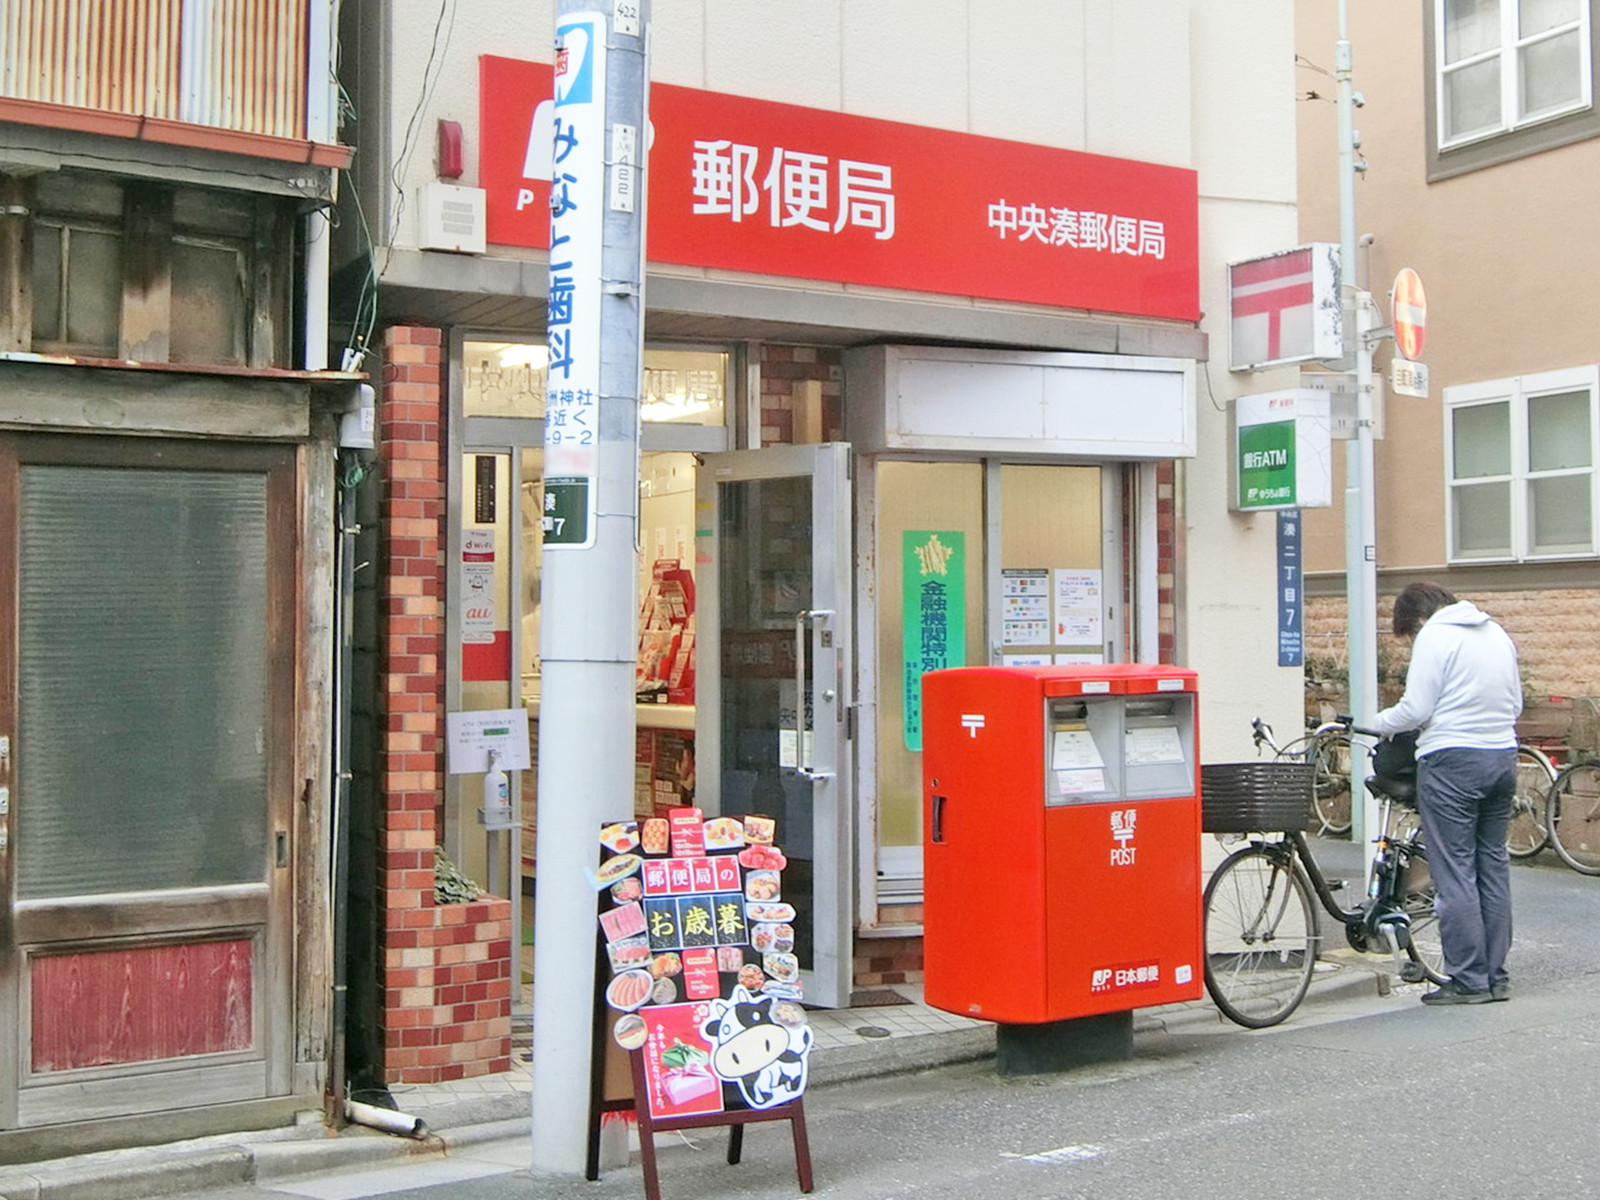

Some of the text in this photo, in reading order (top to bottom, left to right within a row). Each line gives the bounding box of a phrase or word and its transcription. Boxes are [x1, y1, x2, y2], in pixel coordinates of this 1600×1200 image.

[617, 3, 637, 18] 422
[692, 139, 895, 241] 郵便局
[988, 198, 1166, 260] 中央湊郵便局
[1244, 449, 1287, 469] 銀行ATM
[1283, 522, 1297, 627] 湊二丁目7
[466, 608, 492, 620] au
[1110, 809, 1137, 830] 郵便
[1110, 847, 1137, 866] POST
[648, 867, 734, 888] 郵便局の
[650, 903, 745, 937] お歳暮
[1115, 965, 1160, 987] 日本郵便
